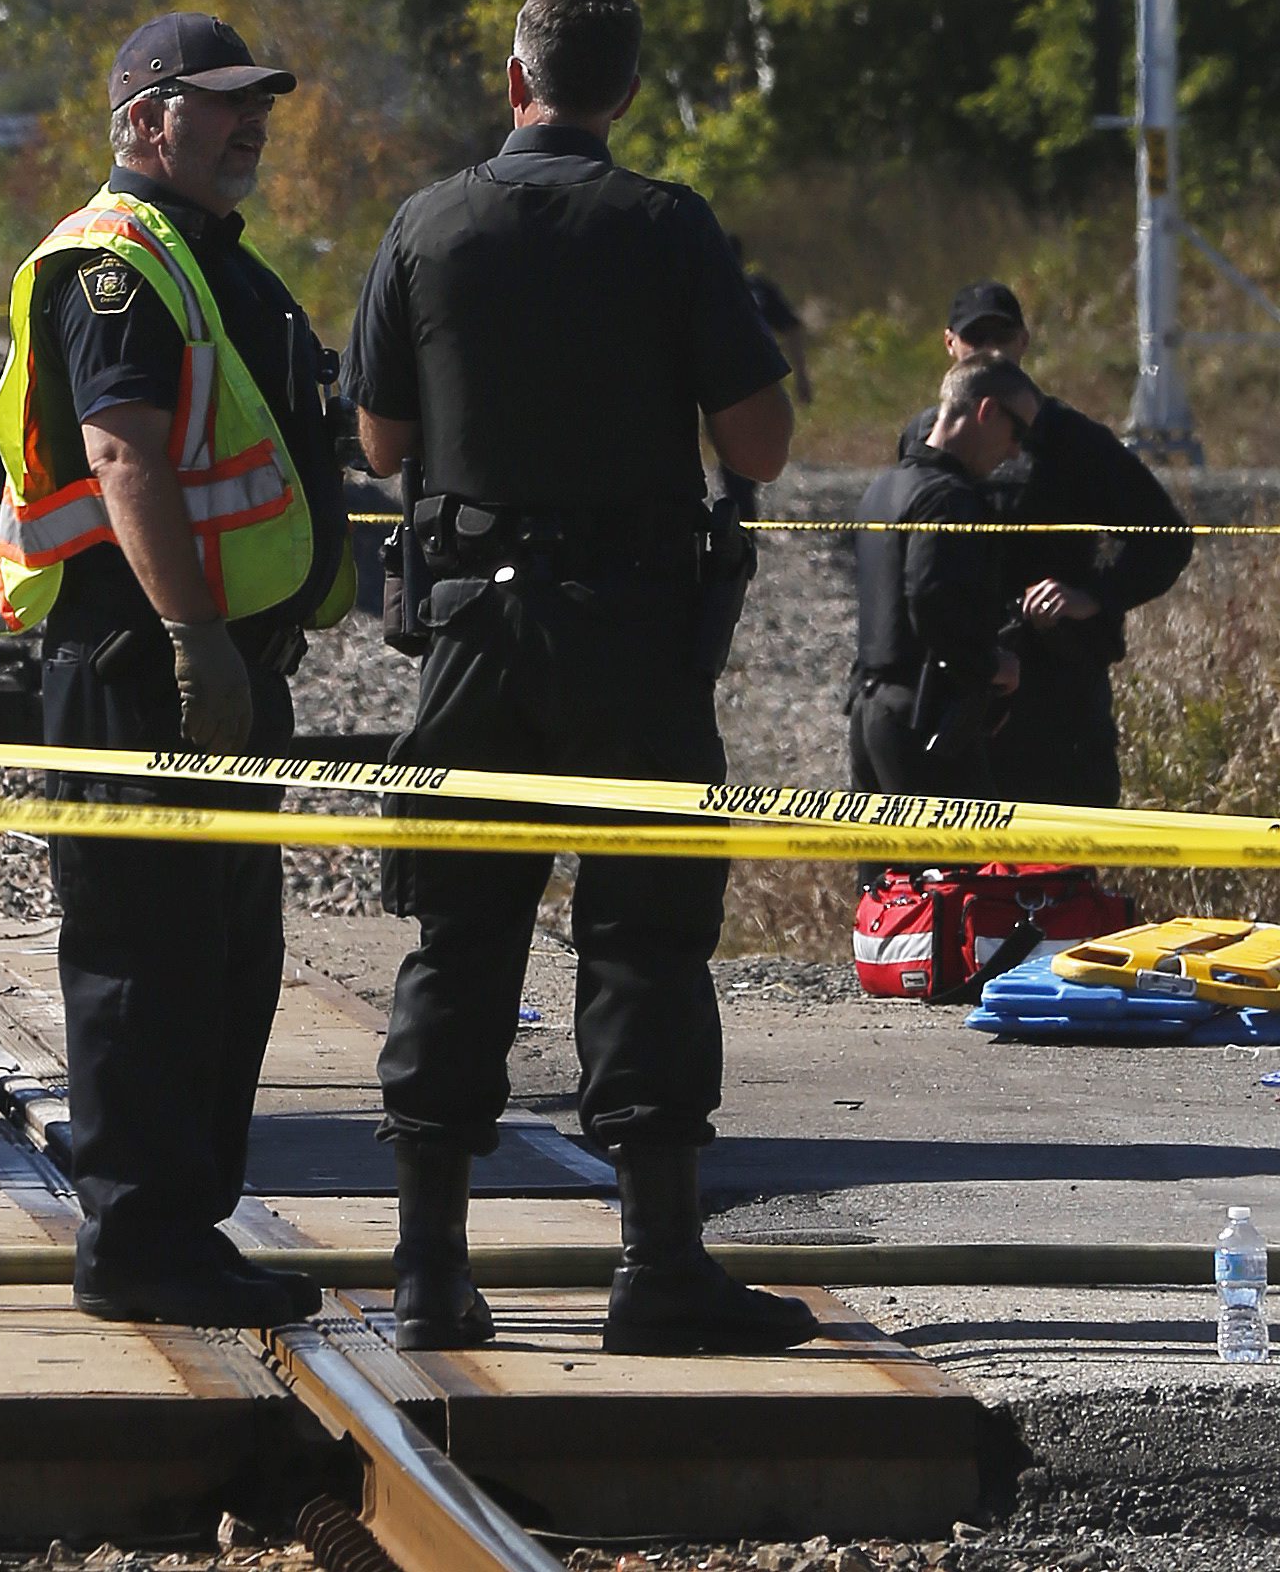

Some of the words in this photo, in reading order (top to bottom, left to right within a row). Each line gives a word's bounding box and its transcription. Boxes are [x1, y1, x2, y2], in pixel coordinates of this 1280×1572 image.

[147, 751, 222, 774] CROSS
[223, 755, 272, 776] NOT
[275, 758, 308, 778] DO
[310, 760, 364, 783] LINE
[366, 764, 449, 789] POLICE
[699, 784, 781, 815] CROSS
[780, 789, 833, 820] NOT
[833, 792, 873, 823] DO
[870, 795, 928, 827] LINE
[928, 799, 1016, 831] POLICE
